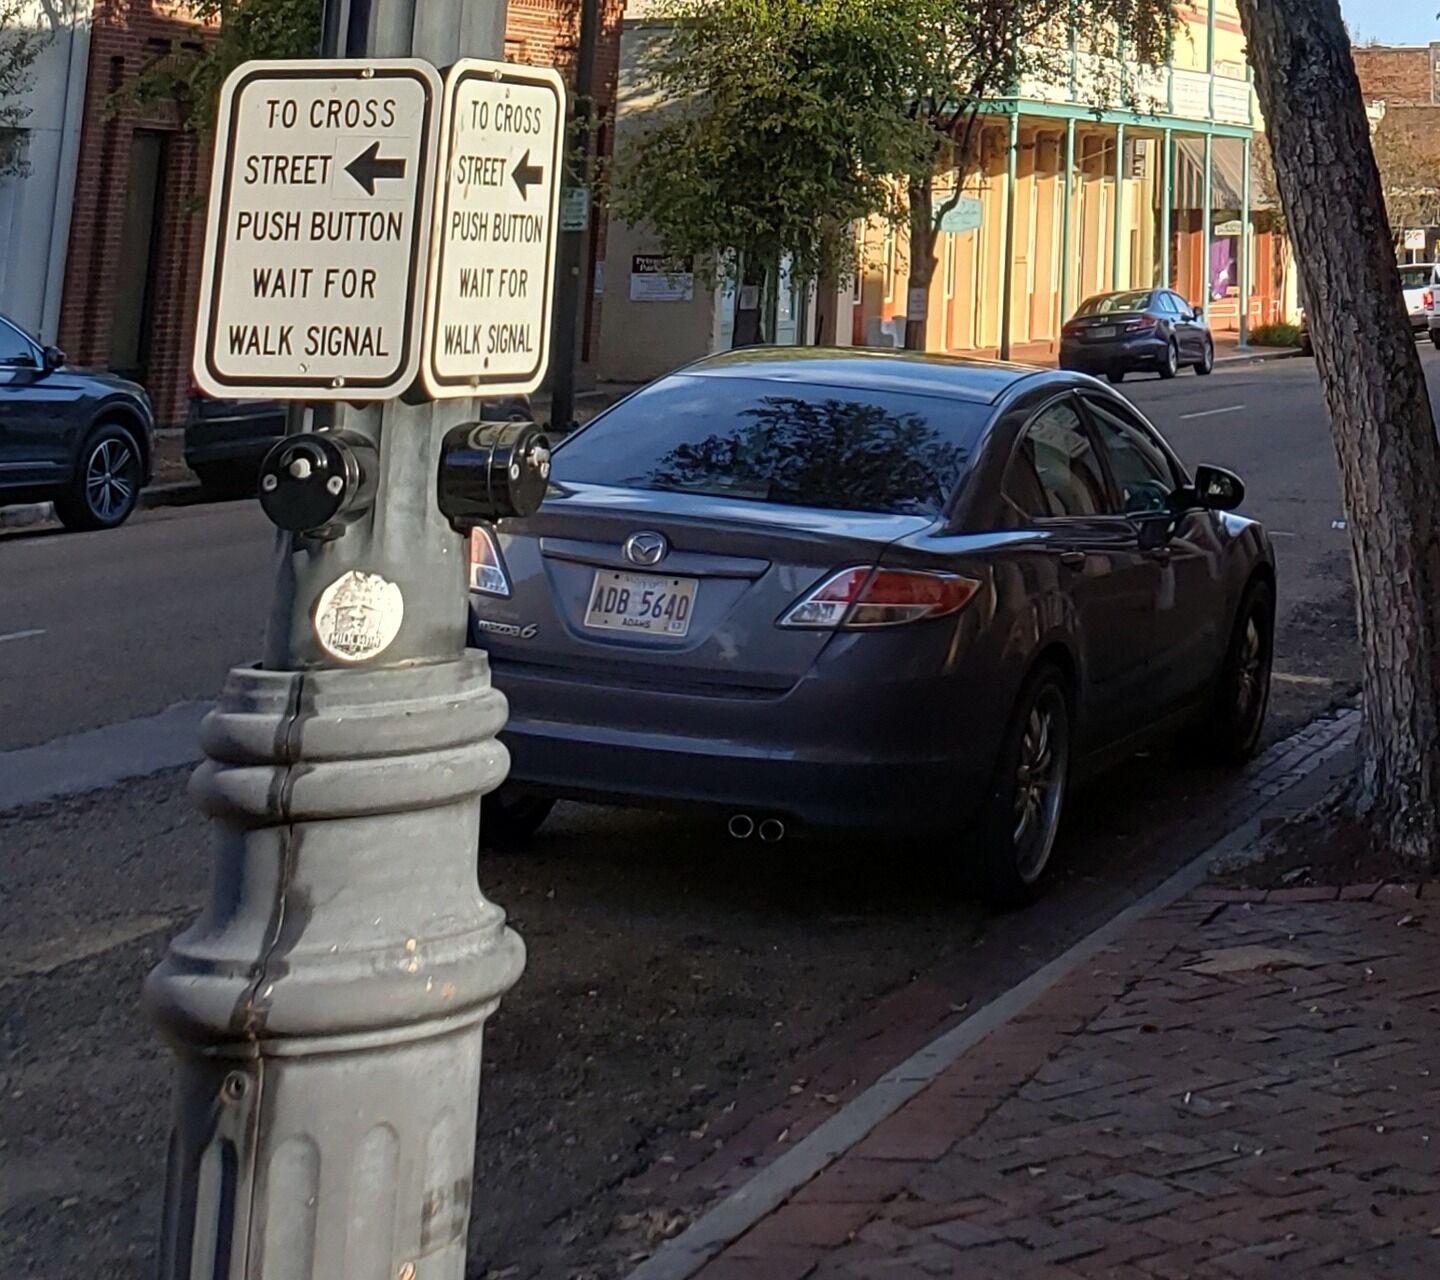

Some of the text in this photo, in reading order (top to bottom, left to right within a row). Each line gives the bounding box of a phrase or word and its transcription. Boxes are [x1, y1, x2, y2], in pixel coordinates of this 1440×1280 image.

[267, 99, 397, 129] TO CROSS
[471, 100, 542, 135] TO CROSS
[244, 155, 332, 185] STREET
[457, 155, 507, 187] STREET
[236, 211, 403, 241] PUSH BUTTON
[451, 211, 543, 243] PUSH BUTTON
[253, 268, 377, 298] WAIT FOR
[459, 268, 528, 298] WAIT FOR
[229, 325, 389, 357] WALK SIGNAL
[444, 323, 533, 355] WALK SIGNAL
[591, 585, 690, 621] ADB 5640
